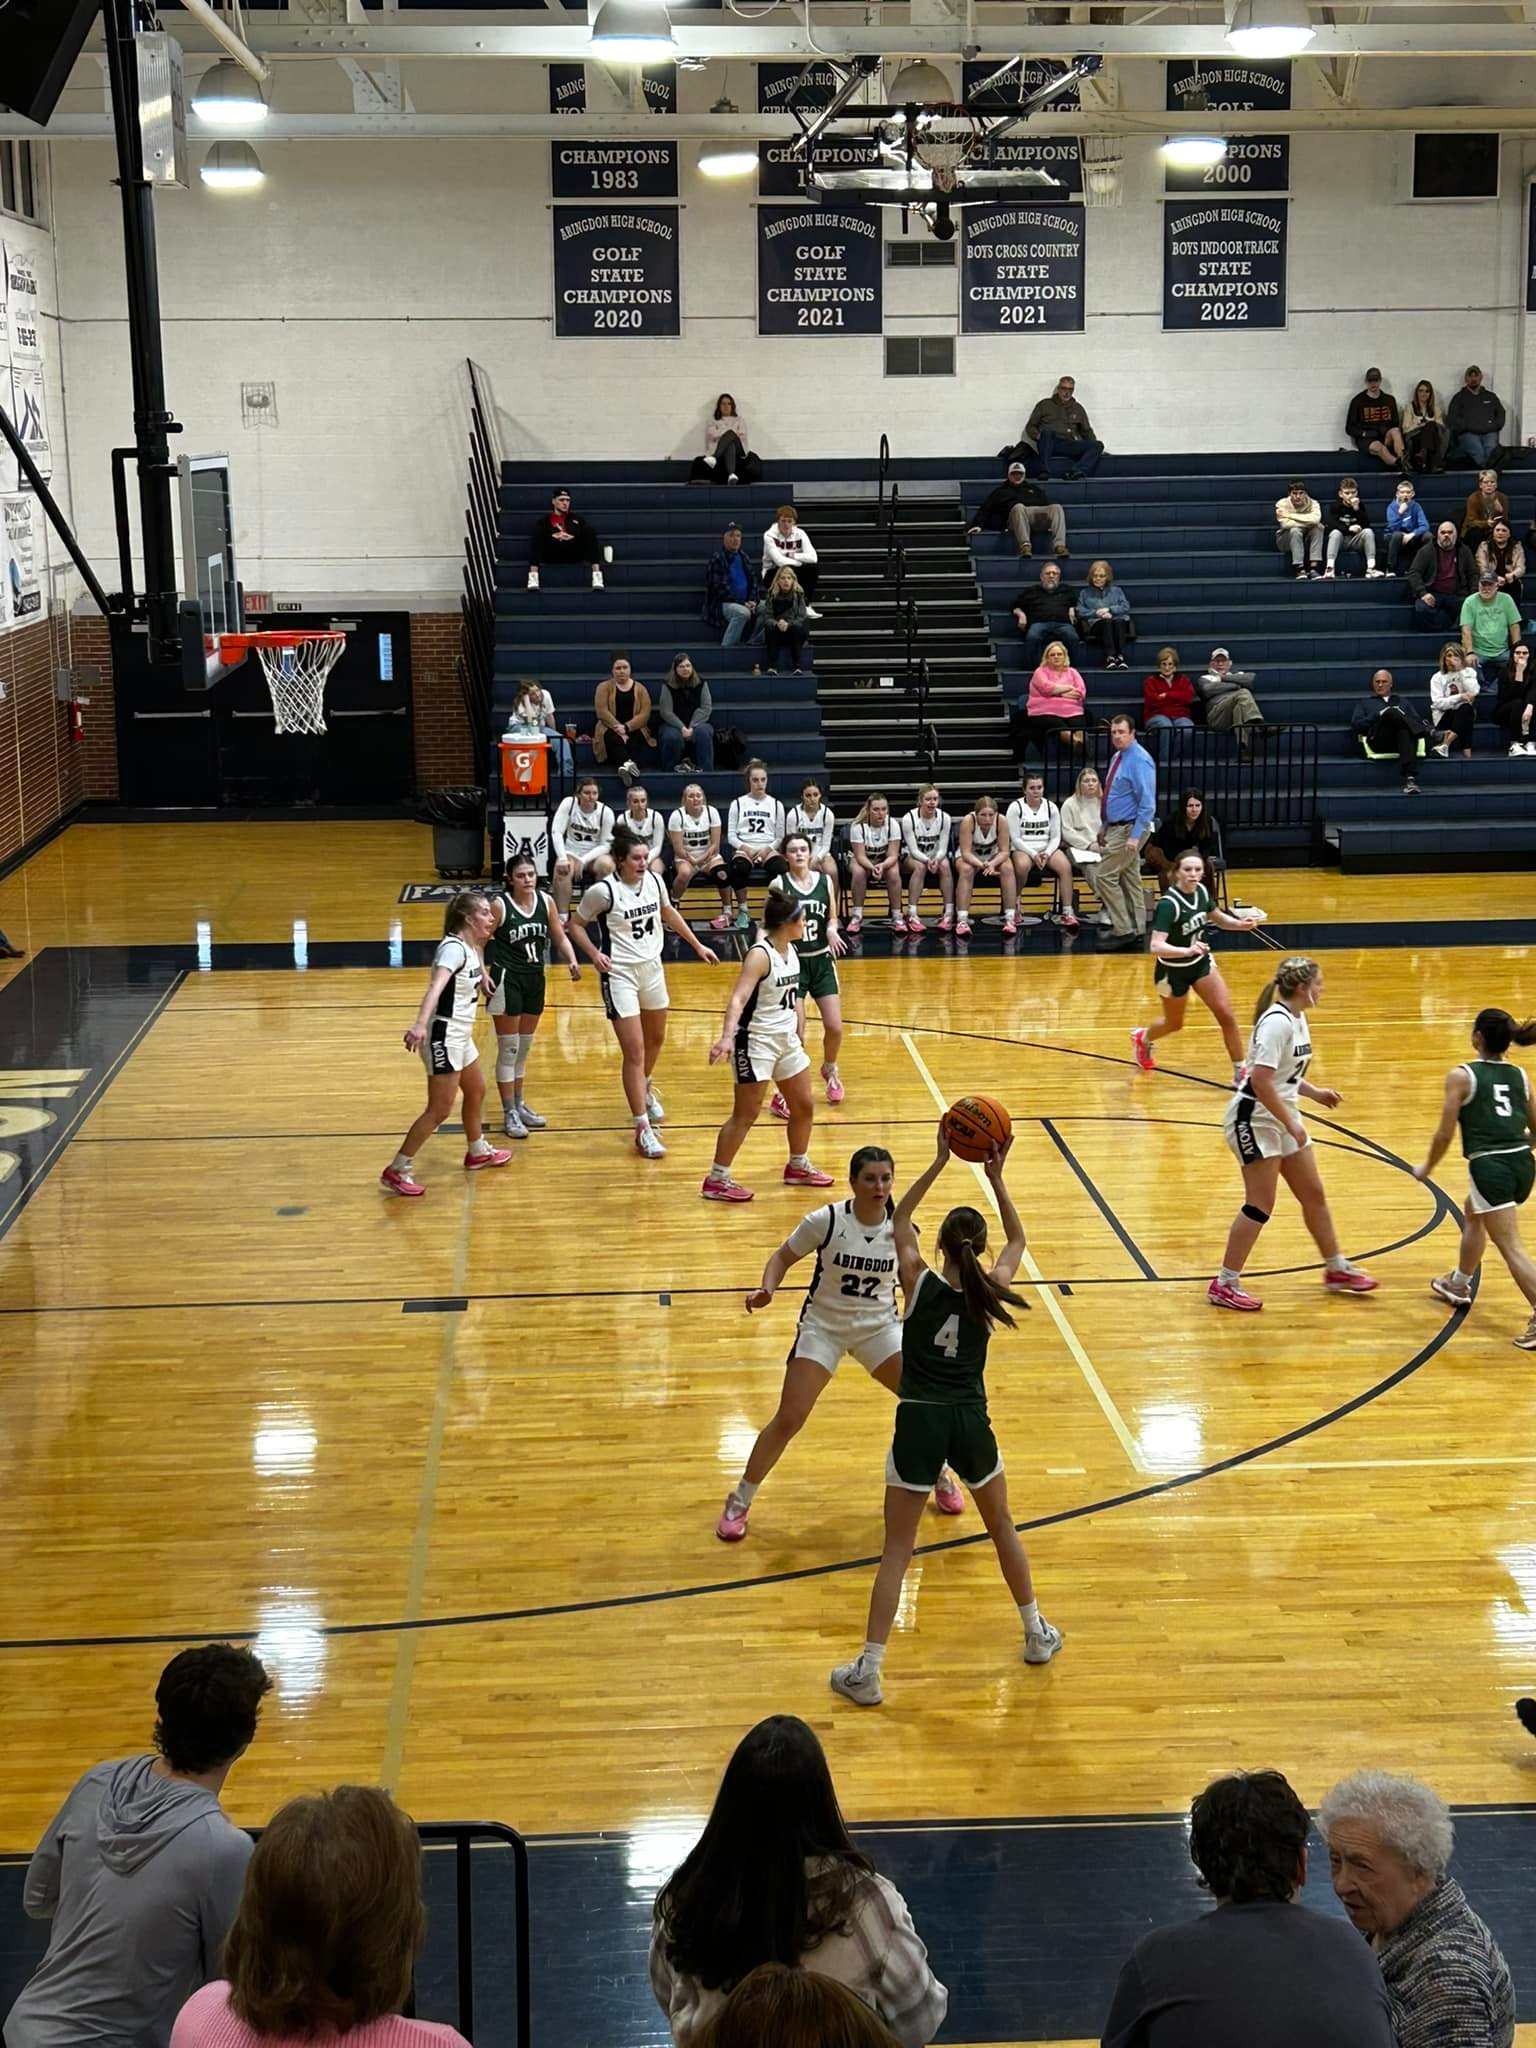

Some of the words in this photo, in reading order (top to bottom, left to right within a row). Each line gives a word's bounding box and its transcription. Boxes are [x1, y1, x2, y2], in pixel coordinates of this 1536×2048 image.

[556, 78, 585, 100] ABING
[643, 78, 670, 99] HOOL
[1224, 69, 1248, 83] HIGH
[1249, 72, 1285, 95] SCHOOL
[560, 150, 670, 164] CHAMPIONS
[1226, 144, 1282, 158] PIONS
[591, 171, 638, 188] 1983
[1203, 165, 1251, 183] 2000
[560, 216, 608, 240] ABINGDON
[611, 215, 635, 228] HIGH
[636, 217, 672, 240] SCHOOL
[764, 214, 813, 239] ABINGDON
[815, 214, 839, 227] HIGH
[840, 216, 876, 239] SCHOOL
[967, 212, 1016, 238] ABINGDON
[1018, 212, 1042, 225] HIGH
[1042, 214, 1079, 237] SCHOOL
[1171, 209, 1219, 235] ABINGDON
[1221, 209, 1245, 222] HIGH
[1245, 211, 1281, 234] SCHOOL
[592, 247, 642, 261] GOLF
[796, 246, 845, 260] GOLF
[967, 245, 993, 258] BOYS
[995, 244, 1028, 258] CROSS
[1030, 244, 1079, 257] COUNTRY
[1172, 242, 1198, 255] BOYS
[1200, 241, 1243, 255] INDOOR
[1244, 240, 1279, 254] TRACK
[591, 269, 644, 282] STATE
[794, 267, 847, 281] STATE
[997, 265, 1049, 279] STATE
[1199, 262, 1252, 276] STATE
[564, 290, 672, 304] CHAMPIONS
[767, 288, 874, 302] CHAMPIONS
[969, 286, 1077, 300] CHAMPIONS
[1171, 282, 1278, 297] CHAMPIONS
[594, 310, 642, 328] 2020
[798, 308, 844, 326] 2021
[1000, 306, 1046, 324] 2021
[1201, 302, 1248, 320] 2022
[516, 753, 530, 768] G
[749, 818, 765, 833] 52
[510, 923, 548, 944] BATTL
[631, 916, 654, 940] 54
[1493, 1084, 1512, 1117] 5
[833, 1252, 895, 1273] ABINGDON
[934, 1314, 960, 1358] 4
